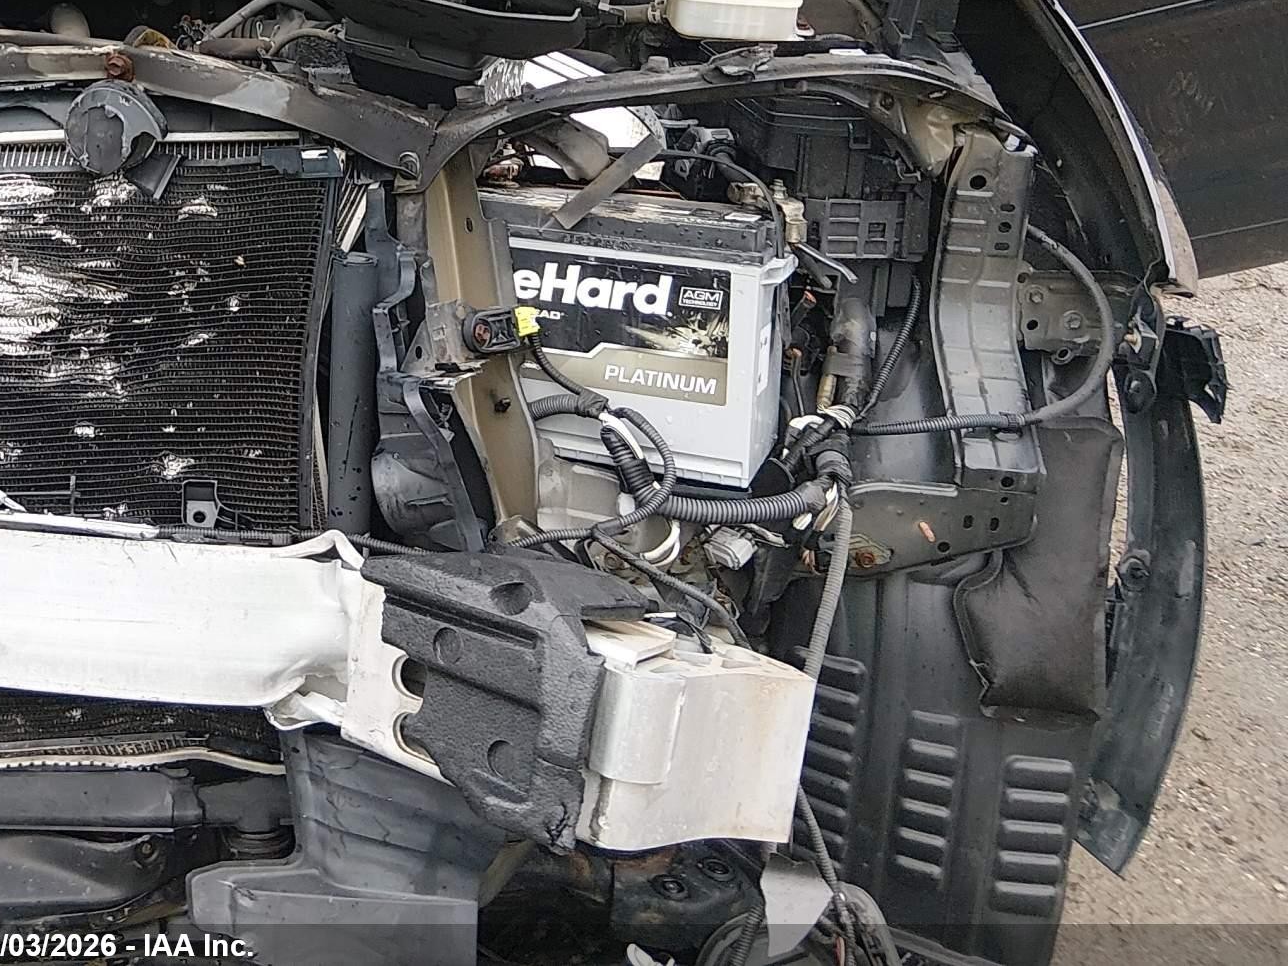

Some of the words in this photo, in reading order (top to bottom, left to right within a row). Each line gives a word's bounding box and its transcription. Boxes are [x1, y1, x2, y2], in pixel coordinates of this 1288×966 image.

[513, 262, 673, 317] eHard
[683, 290, 720, 303] AGM
[604, 365, 717, 395] PLATINUM
